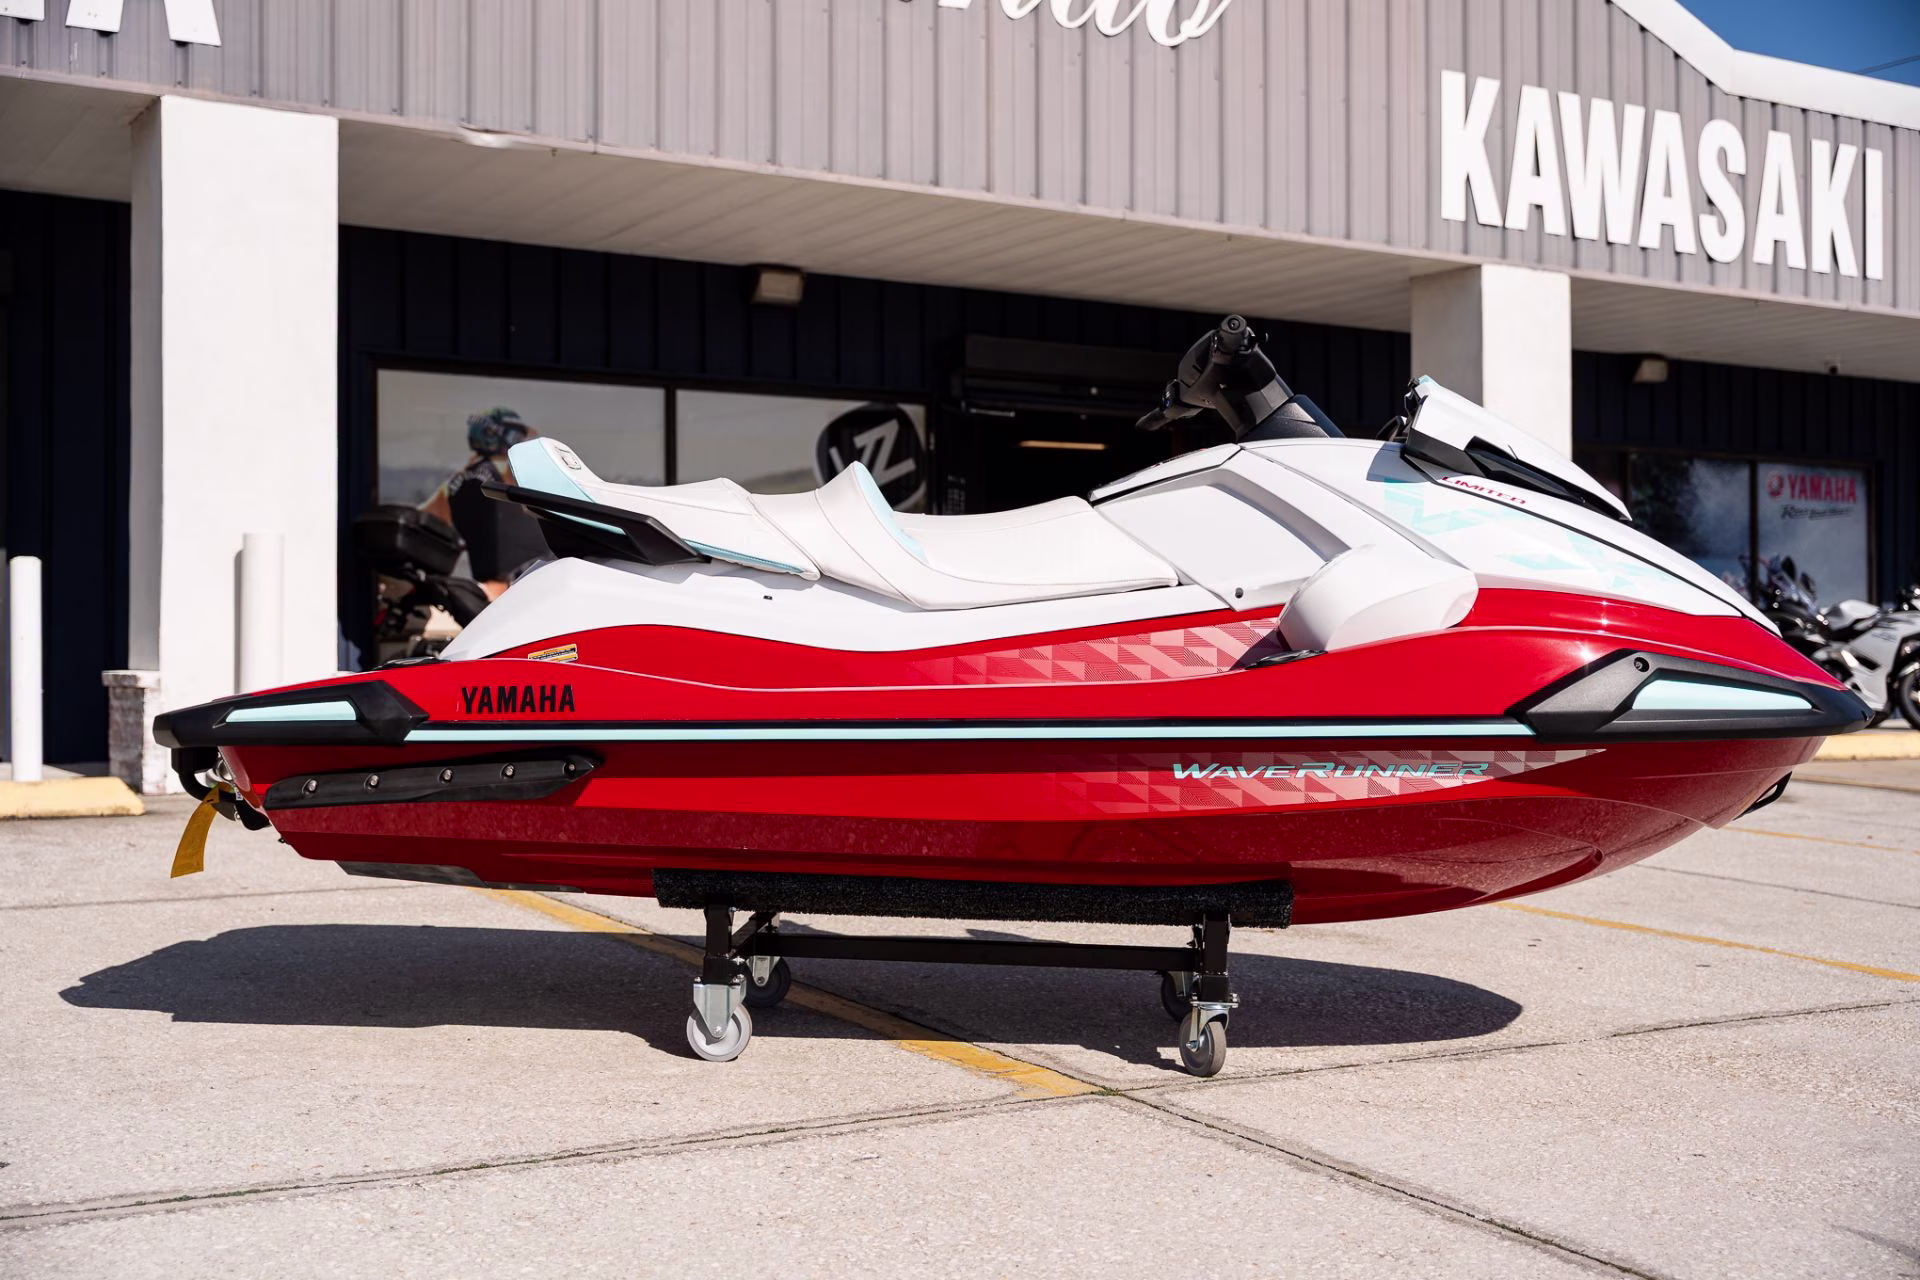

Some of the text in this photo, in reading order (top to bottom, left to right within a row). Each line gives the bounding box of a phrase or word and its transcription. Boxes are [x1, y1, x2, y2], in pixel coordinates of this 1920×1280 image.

[1441, 70, 1883, 281] KAWASAKI
[1442, 476, 1526, 505] LIMITED
[1787, 473, 1857, 503] YAMAHA
[461, 685, 576, 714] YAMAHA
[1172, 761, 1490, 780] WAVERUNNER
